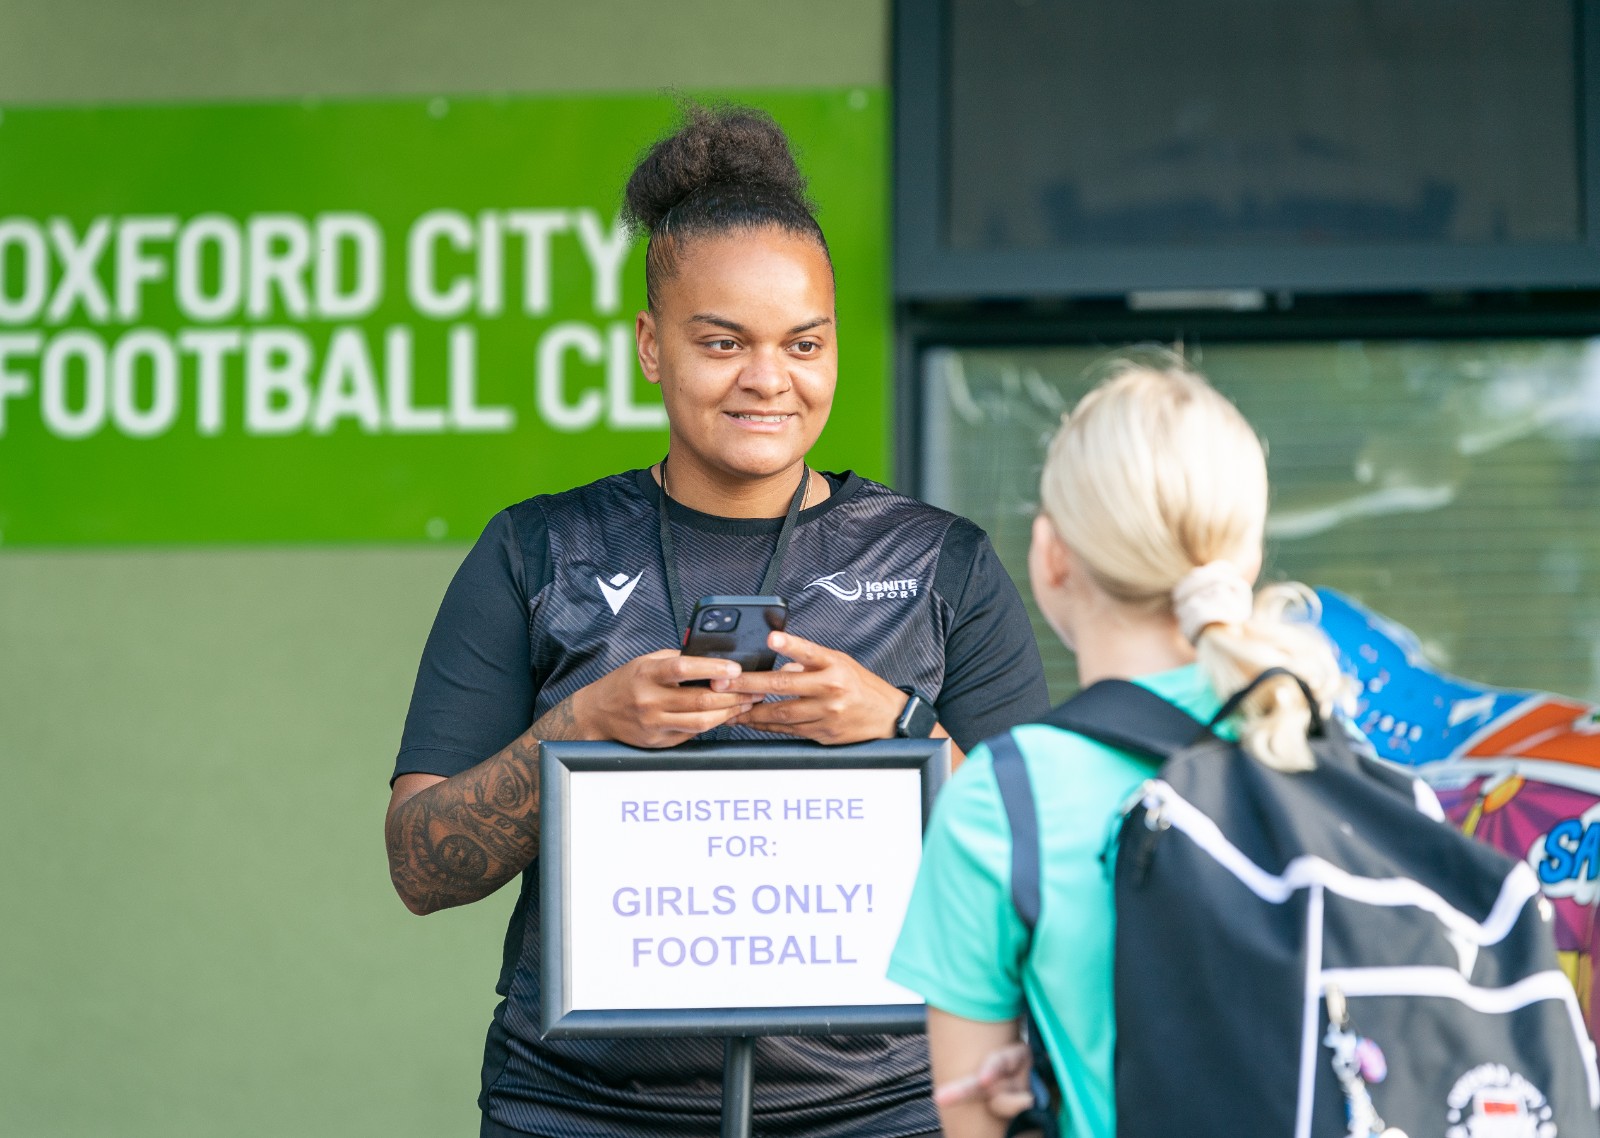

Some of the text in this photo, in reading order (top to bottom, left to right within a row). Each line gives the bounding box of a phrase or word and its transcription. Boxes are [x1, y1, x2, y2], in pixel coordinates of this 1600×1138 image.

[0, 209, 632, 322] OXFORD CITY
[0, 326, 514, 437] FOOTBALL
[865, 579, 918, 592] IGNITE
[865, 589, 917, 600] SPORT
[621, 798, 865, 822] REGISTER HERE
[707, 835, 778, 857] FOR:
[612, 883, 874, 917] GIRLS ONLY!
[632, 935, 858, 967] FOOTBALL
